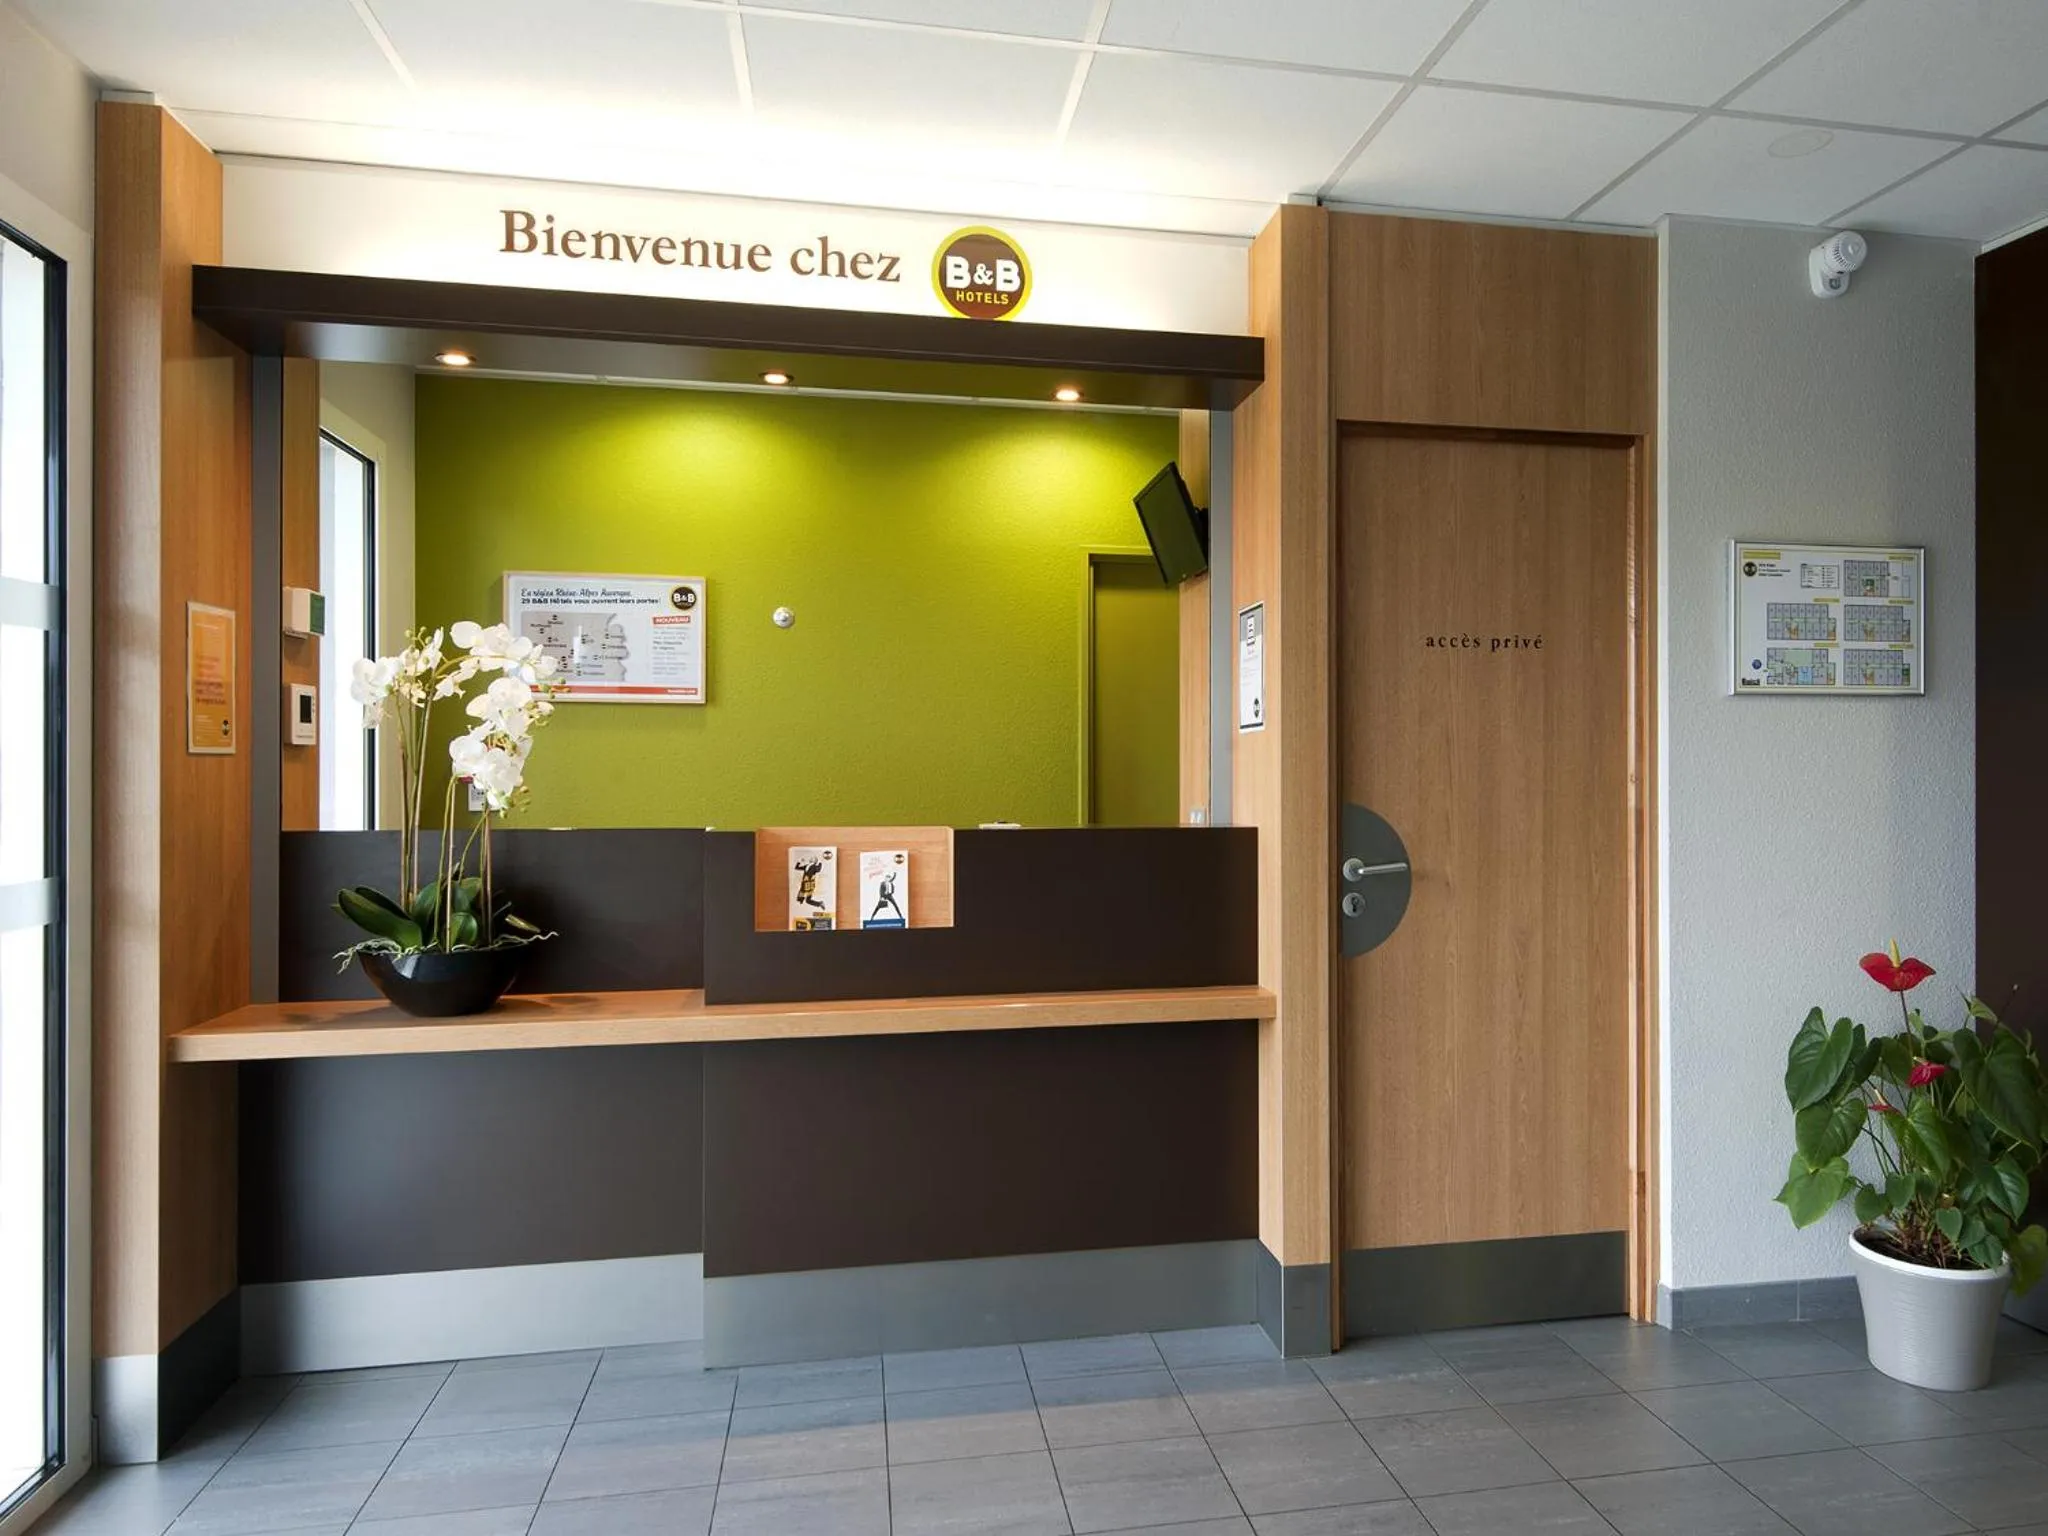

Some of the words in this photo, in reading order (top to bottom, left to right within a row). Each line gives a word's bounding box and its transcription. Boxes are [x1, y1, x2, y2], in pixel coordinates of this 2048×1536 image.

[499, 210, 772, 273] Bienvenue
[790, 235, 901, 282] chez
[945, 255, 1021, 292] B&B
[956, 290, 1010, 305] HOTELS
[1426, 633, 1481, 649] accès
[1490, 634, 1544, 652] privé
